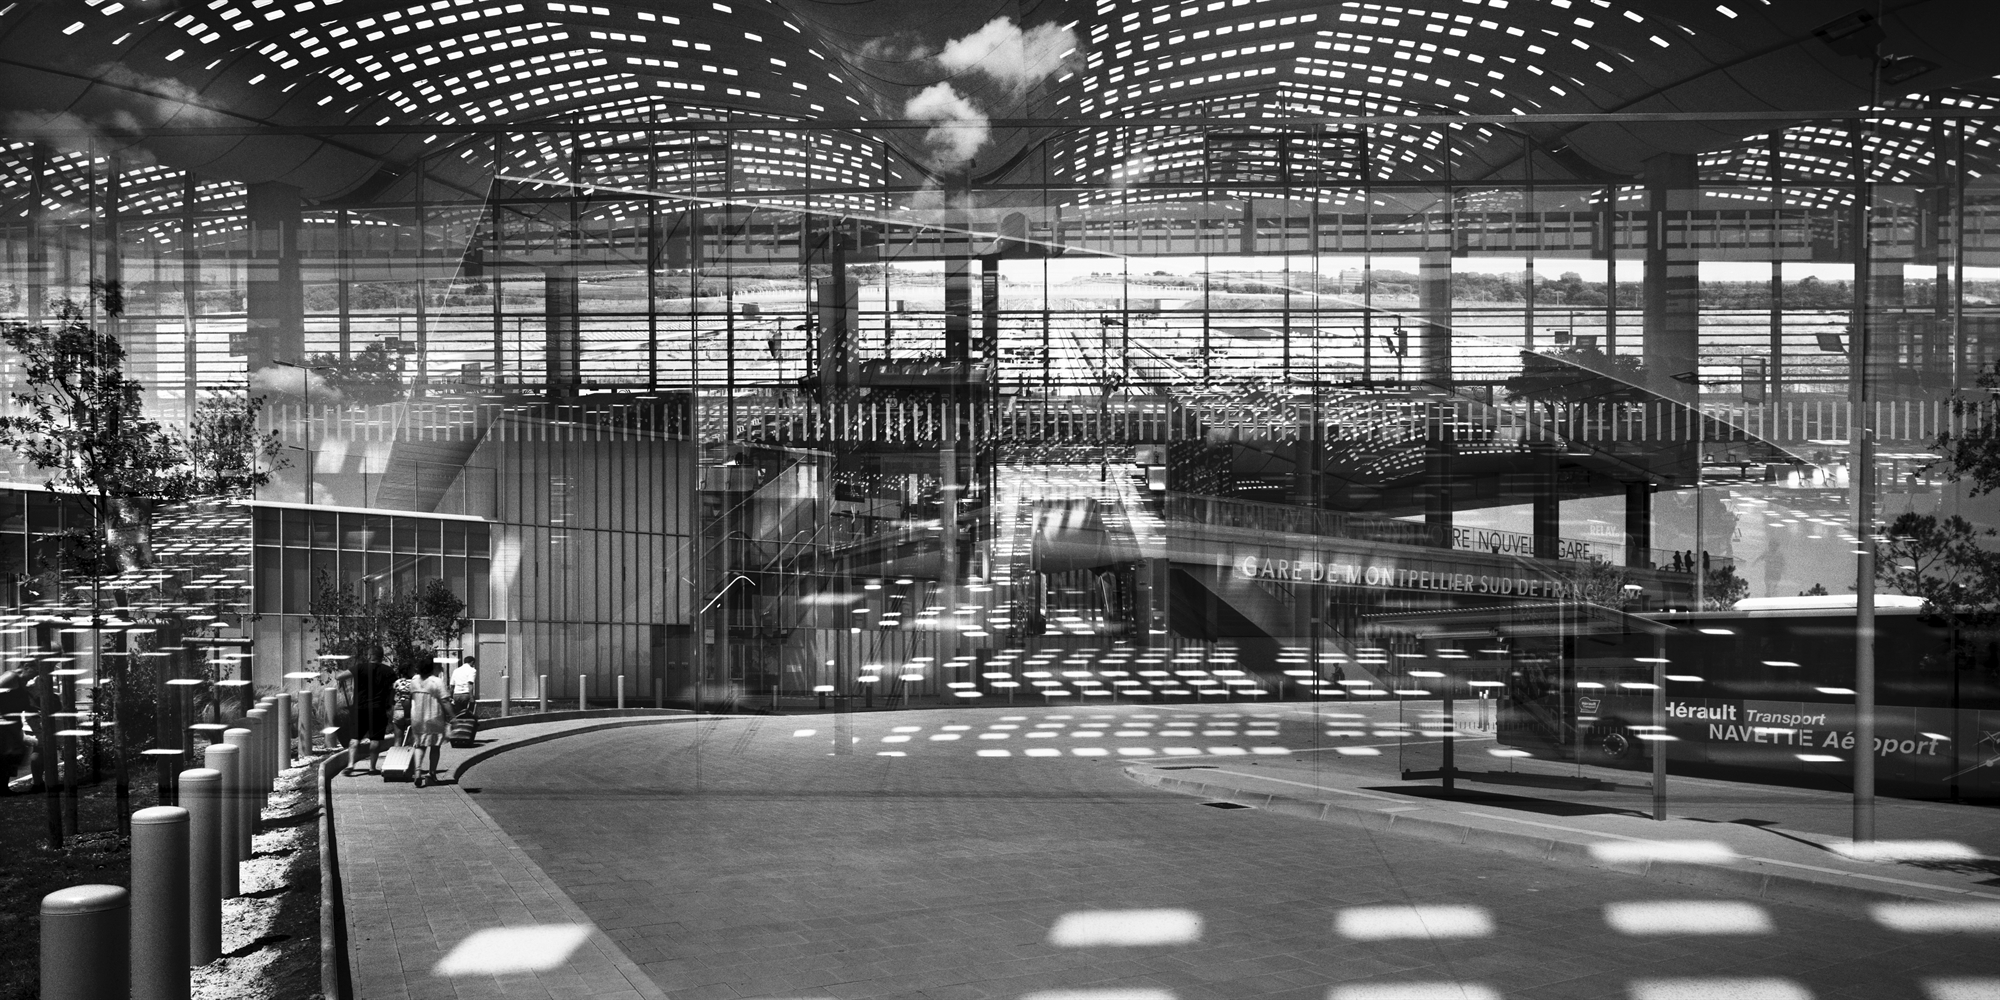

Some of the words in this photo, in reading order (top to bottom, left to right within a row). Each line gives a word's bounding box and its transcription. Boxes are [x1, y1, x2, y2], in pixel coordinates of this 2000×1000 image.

[1478, 530, 1549, 556] NOUVEL
[1558, 540, 1590, 561] GARE
[1243, 555, 1302, 581] GARE
[1311, 561, 1337, 583] DE
[1346, 565, 1474, 593] MONTPELLIER
[1478, 575, 1512, 595] SUD
[1518, 578, 1539, 598] DE
[1746, 709, 1826, 727] Transport
[1709, 723, 1813, 747] NAVETTE
[1822, 731, 1939, 757] Aéport
